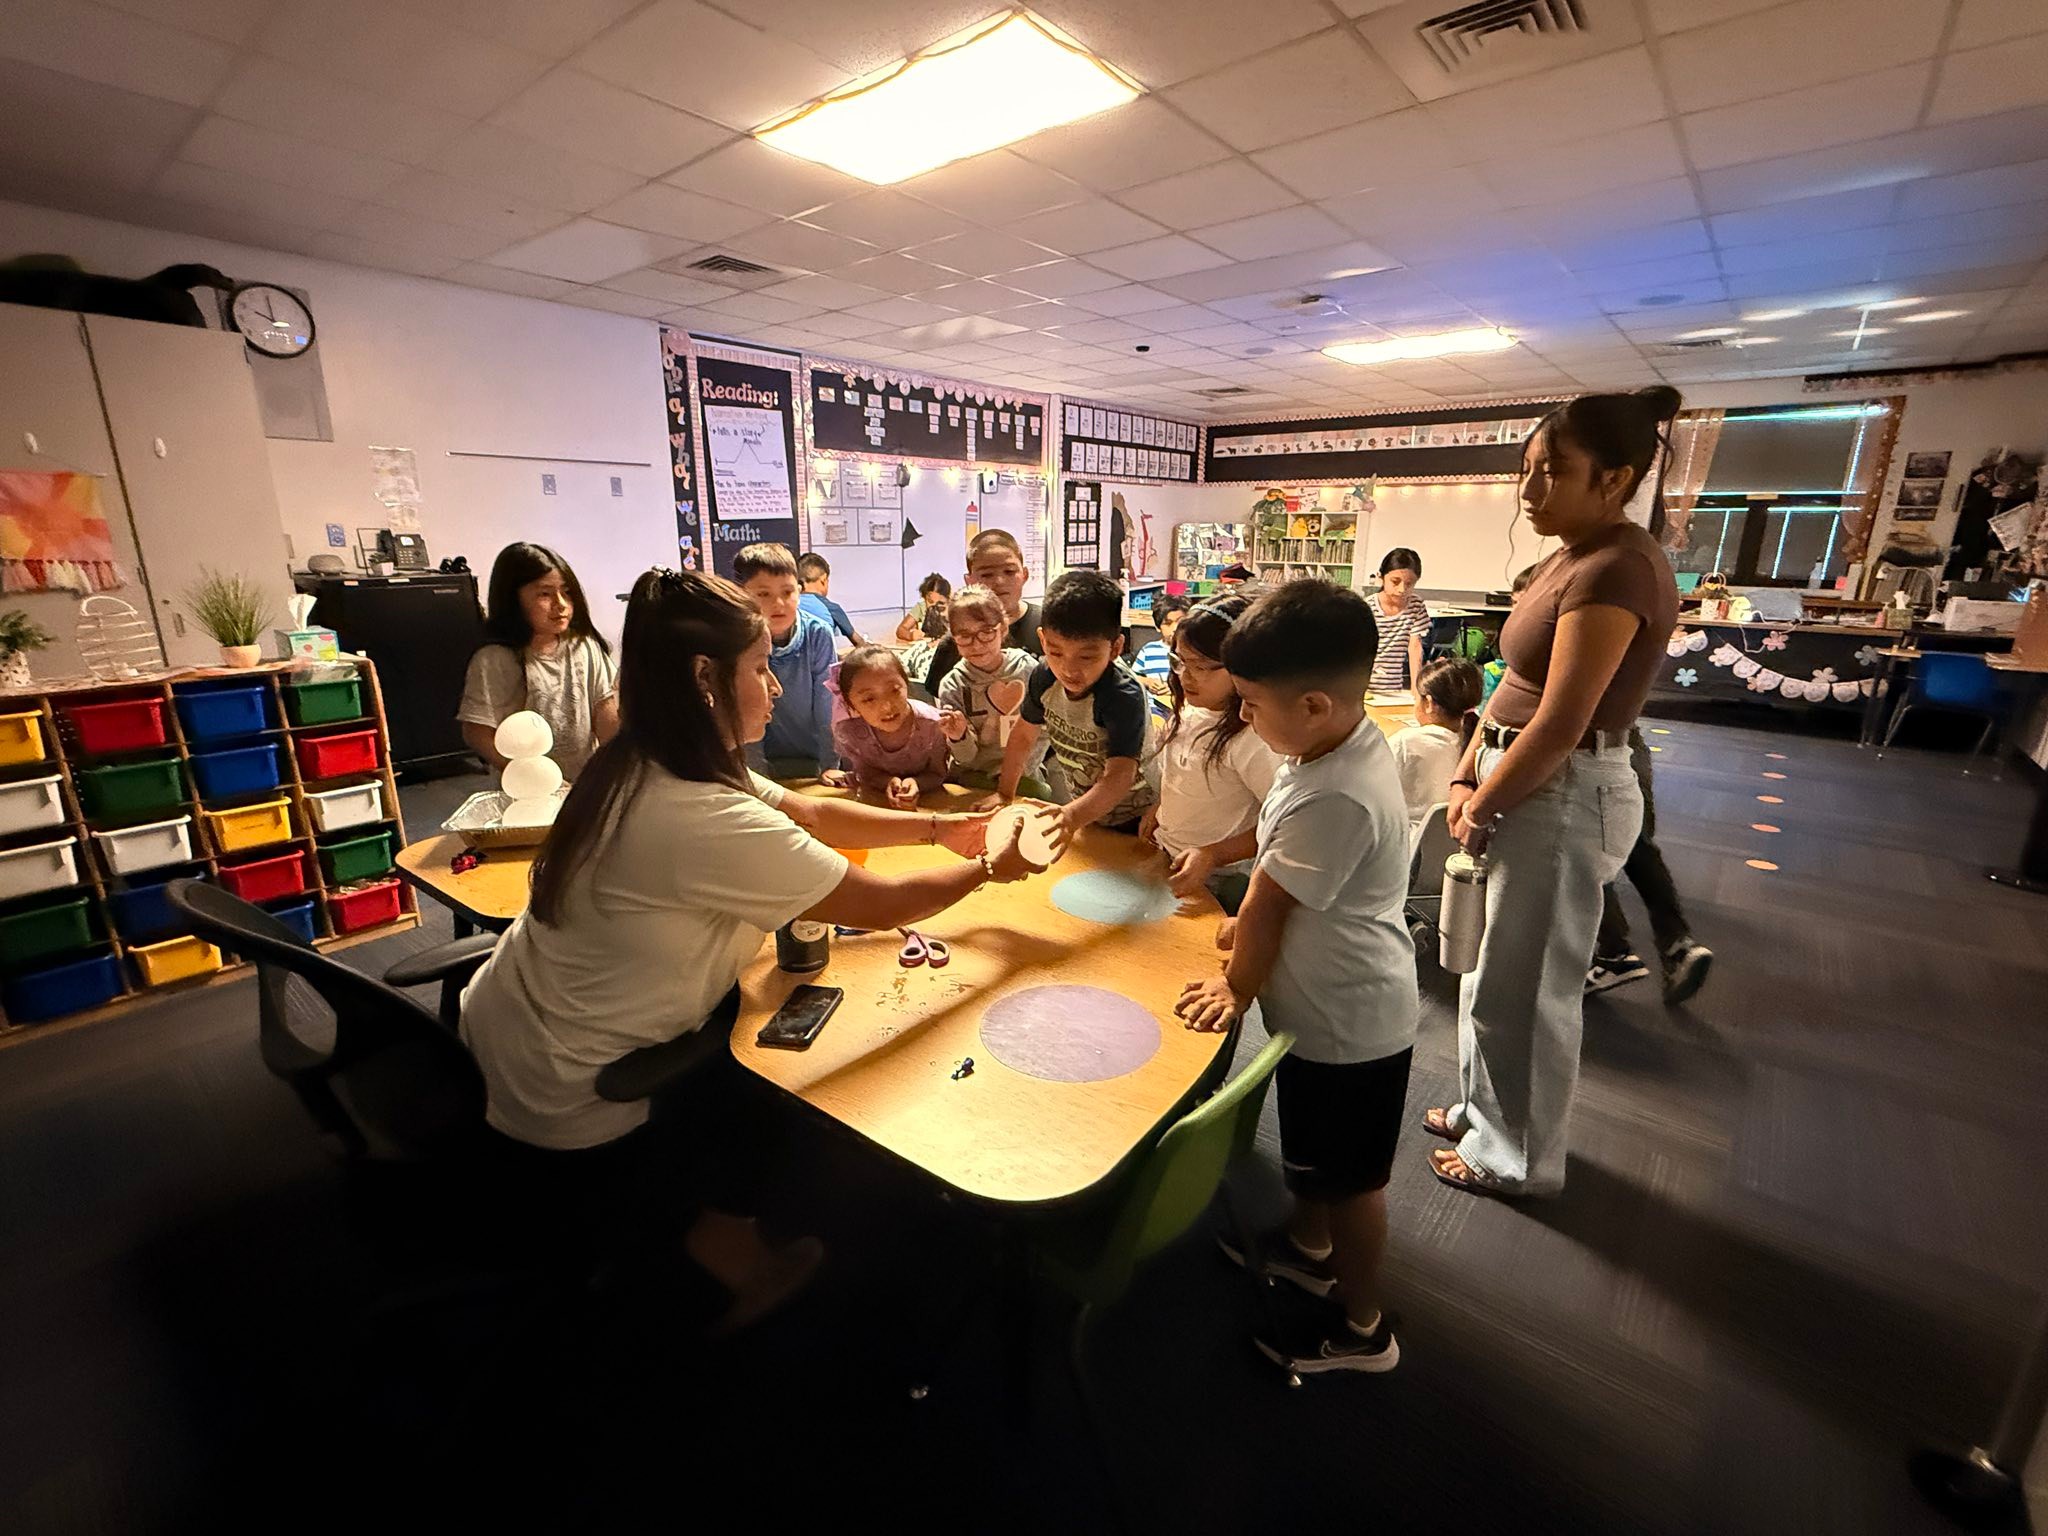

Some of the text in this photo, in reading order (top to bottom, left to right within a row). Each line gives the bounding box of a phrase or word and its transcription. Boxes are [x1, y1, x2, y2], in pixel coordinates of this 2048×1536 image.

[702, 378, 778, 408] Reading:
[713, 523, 760, 541] Math:
[1044, 708, 1067, 731] UPER
